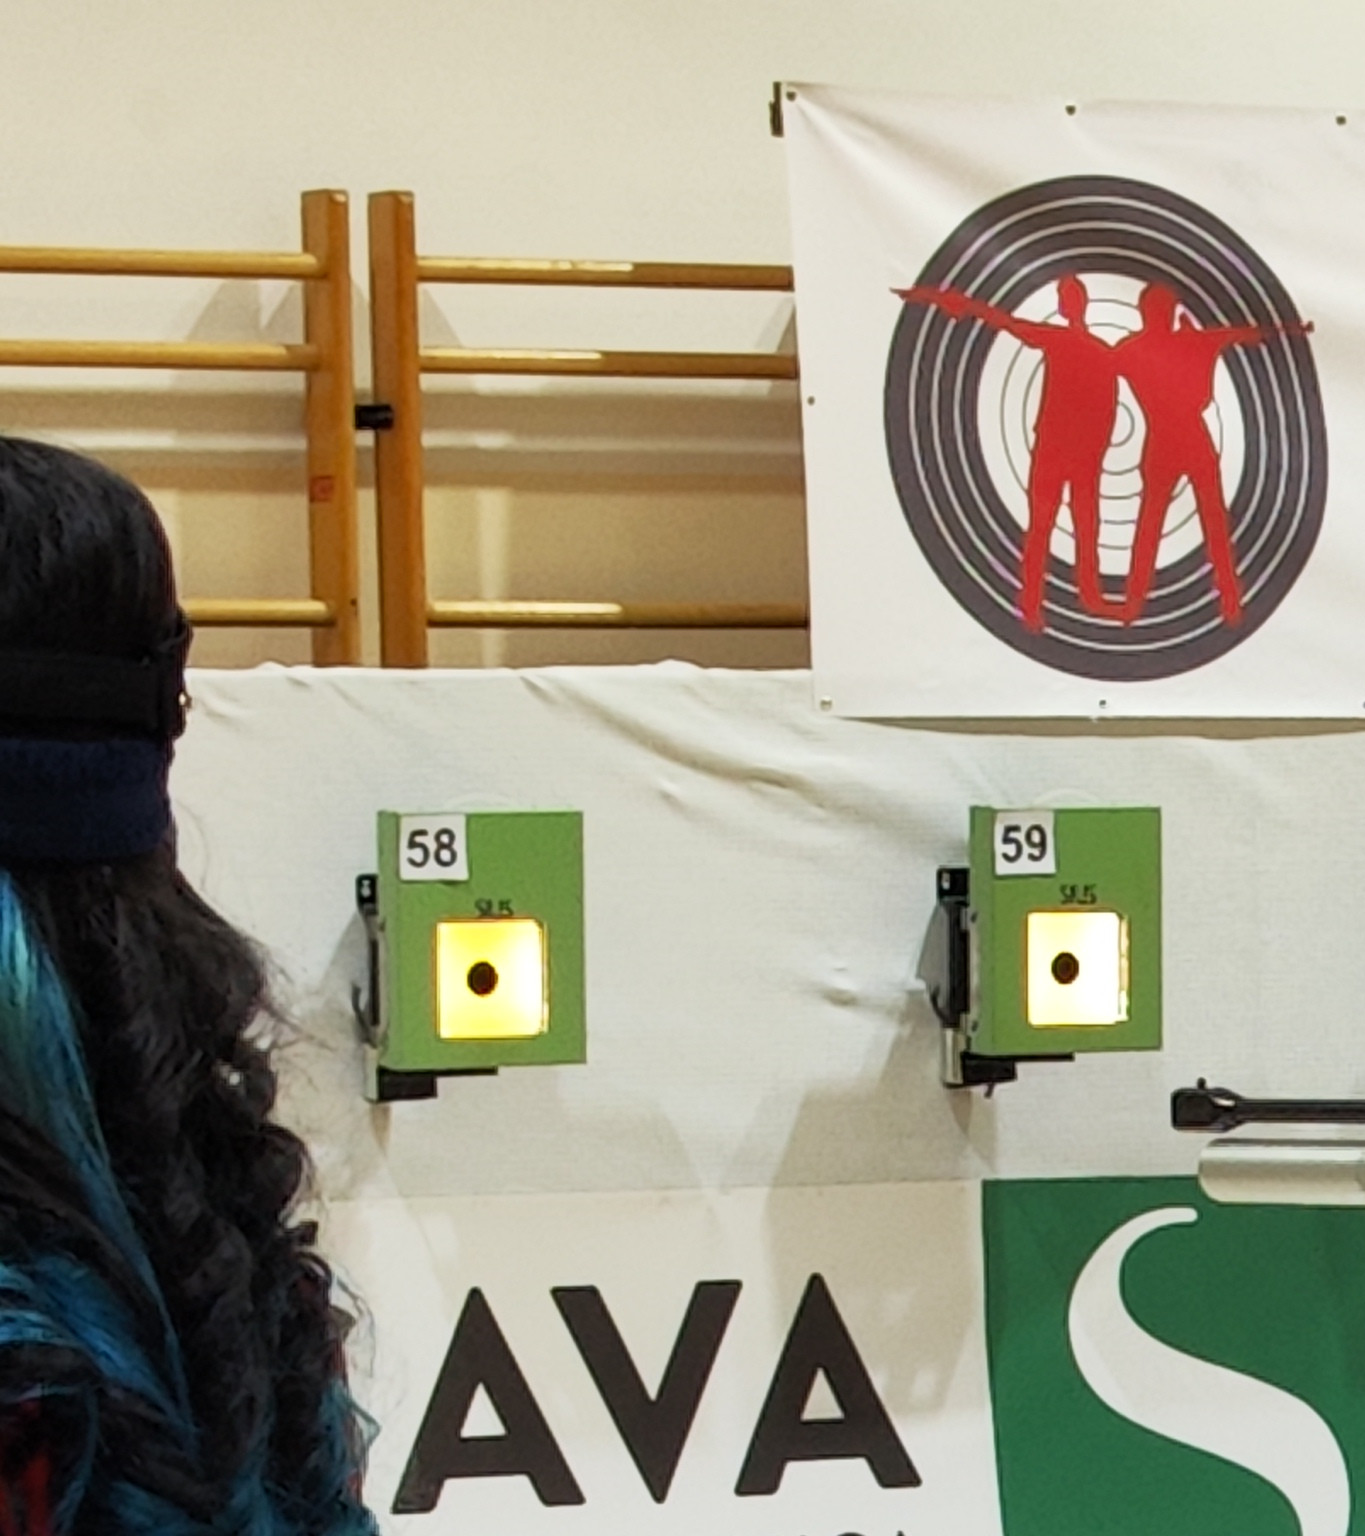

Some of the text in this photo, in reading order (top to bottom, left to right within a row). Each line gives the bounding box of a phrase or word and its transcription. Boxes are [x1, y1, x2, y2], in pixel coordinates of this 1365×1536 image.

[406, 827, 458, 868] 58
[1000, 823, 1048, 864] 59
[391, 1272, 923, 1514] AVA
